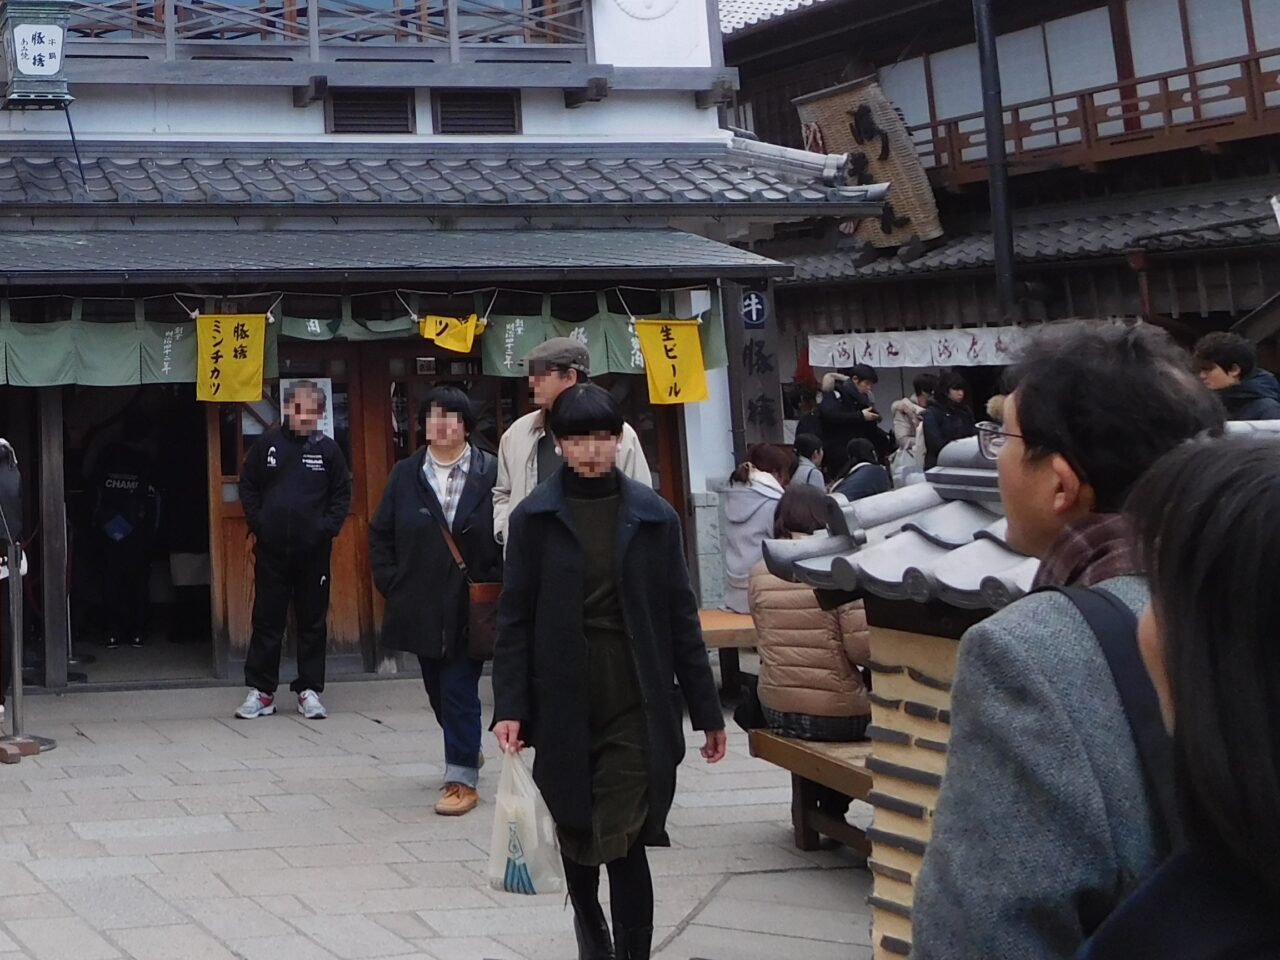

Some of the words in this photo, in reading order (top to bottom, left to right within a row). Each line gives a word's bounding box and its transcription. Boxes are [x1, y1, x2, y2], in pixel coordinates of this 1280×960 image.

[31, 31, 46, 67] 豚捨
[740, 293, 763, 321] 牛
[209, 320, 224, 396] ミンチカツ
[232, 321, 250, 360] 豚捨
[659, 325, 682, 399] 生ビール
